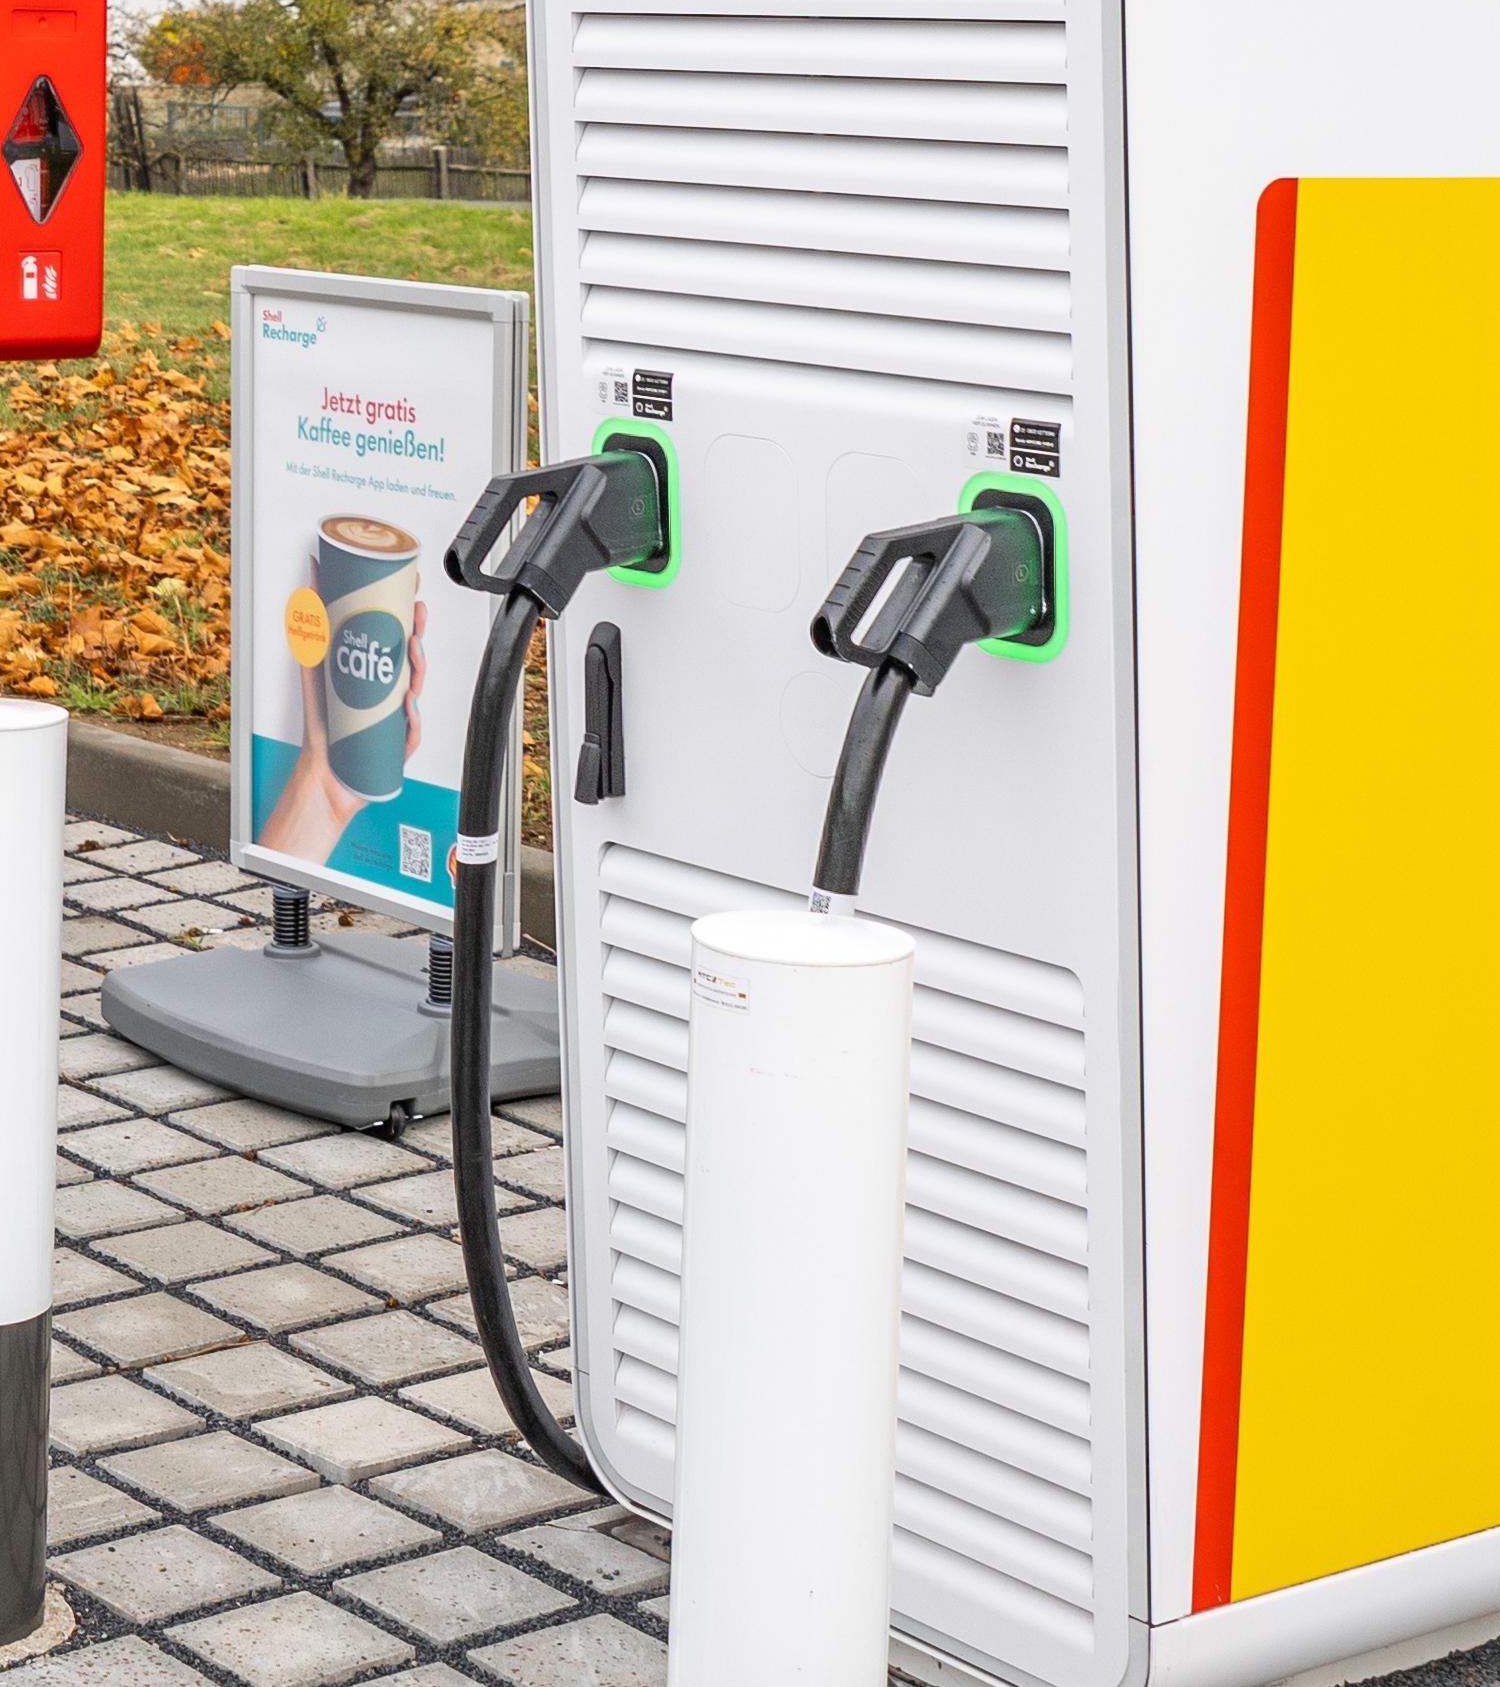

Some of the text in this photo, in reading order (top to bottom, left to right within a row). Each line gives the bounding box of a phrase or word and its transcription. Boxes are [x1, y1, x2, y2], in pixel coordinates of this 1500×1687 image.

[263, 310, 283, 322] Shell
[263, 323, 317, 348] Recharge
[321, 387, 416, 425] Jetzt gratis
[298, 415, 444, 462] Kaffee genießen!
[286, 461, 298, 474] Mit
[299, 463, 311, 475] der
[312, 465, 330, 480] Shell
[331, 469, 366, 488] Recharge
[368, 476, 385, 491] App
[386, 477, 409, 493] laden
[411, 484, 426, 497] und
[343, 629, 368, 649] Shell
[336, 640, 394, 685] café
